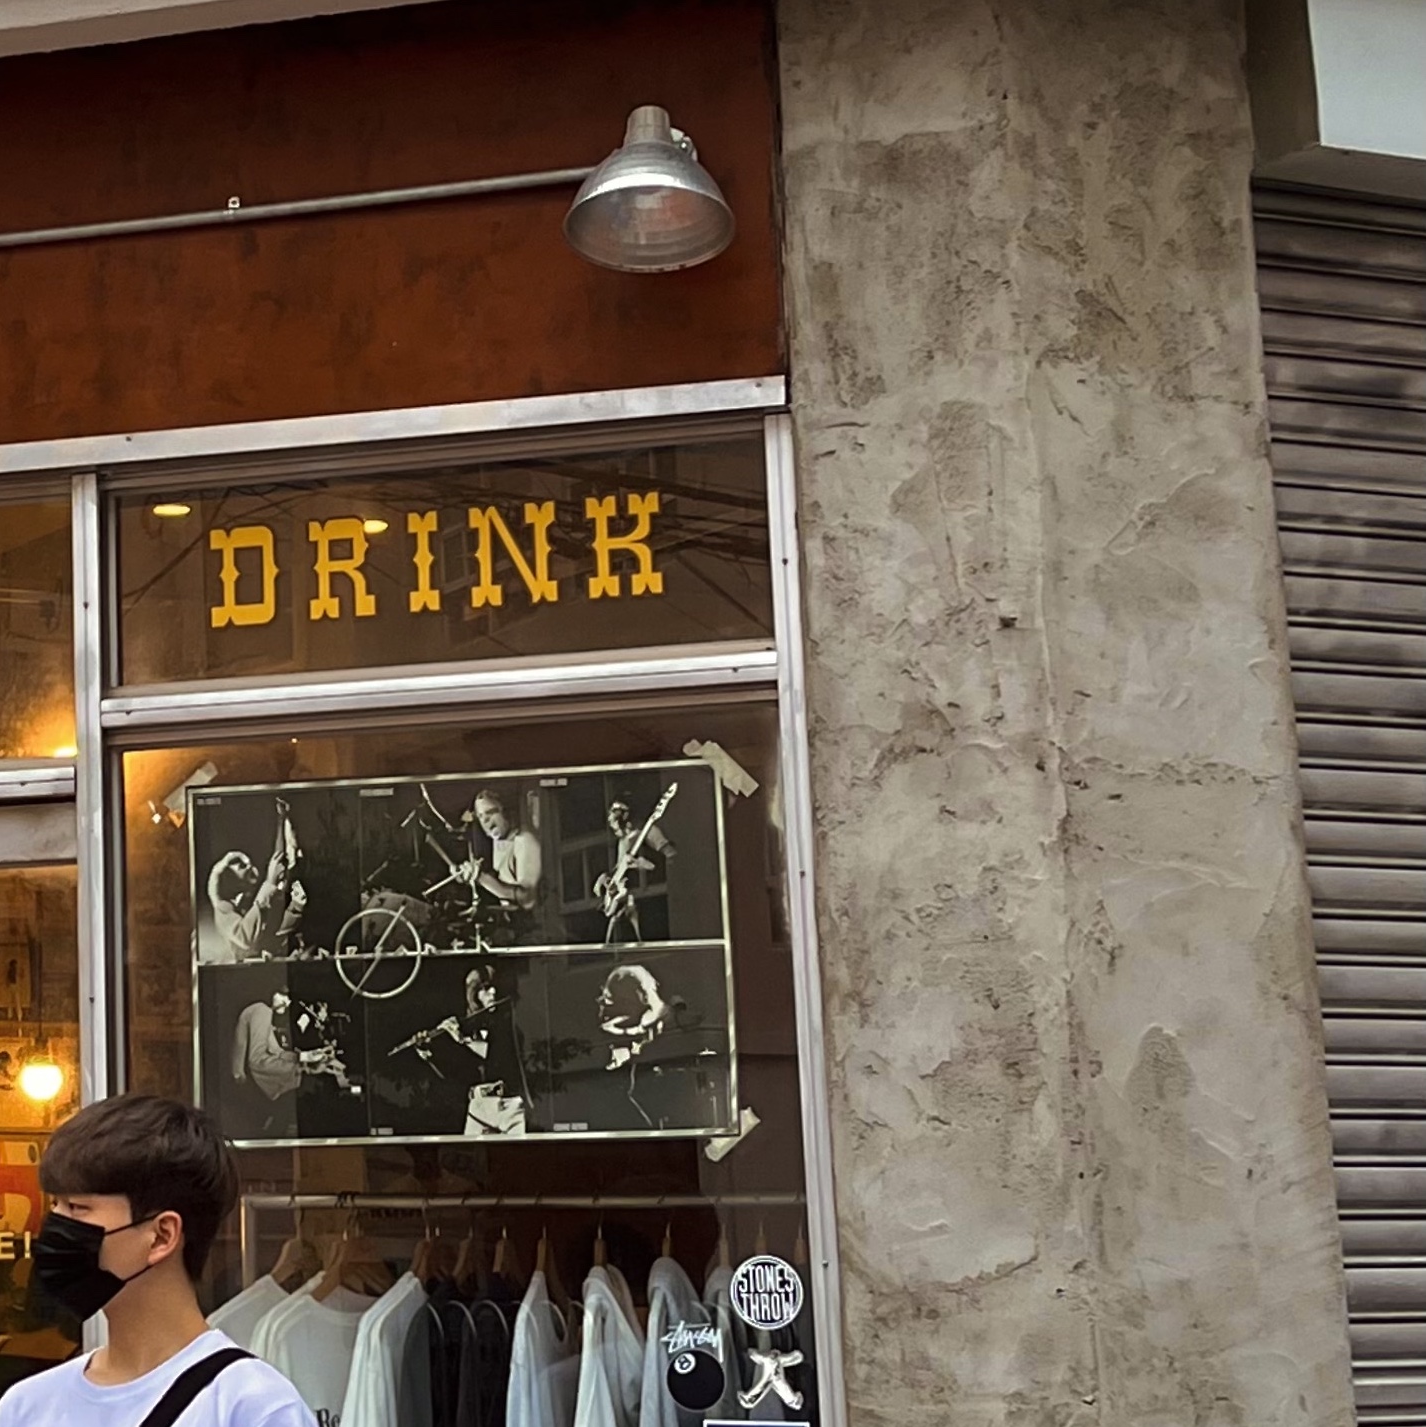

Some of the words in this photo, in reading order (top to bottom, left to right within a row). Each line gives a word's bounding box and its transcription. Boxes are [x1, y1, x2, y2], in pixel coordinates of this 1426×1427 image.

[210, 491, 664, 628] DRINK
[739, 1263, 795, 1293] STONES
[740, 1291, 794, 1321] THROW
